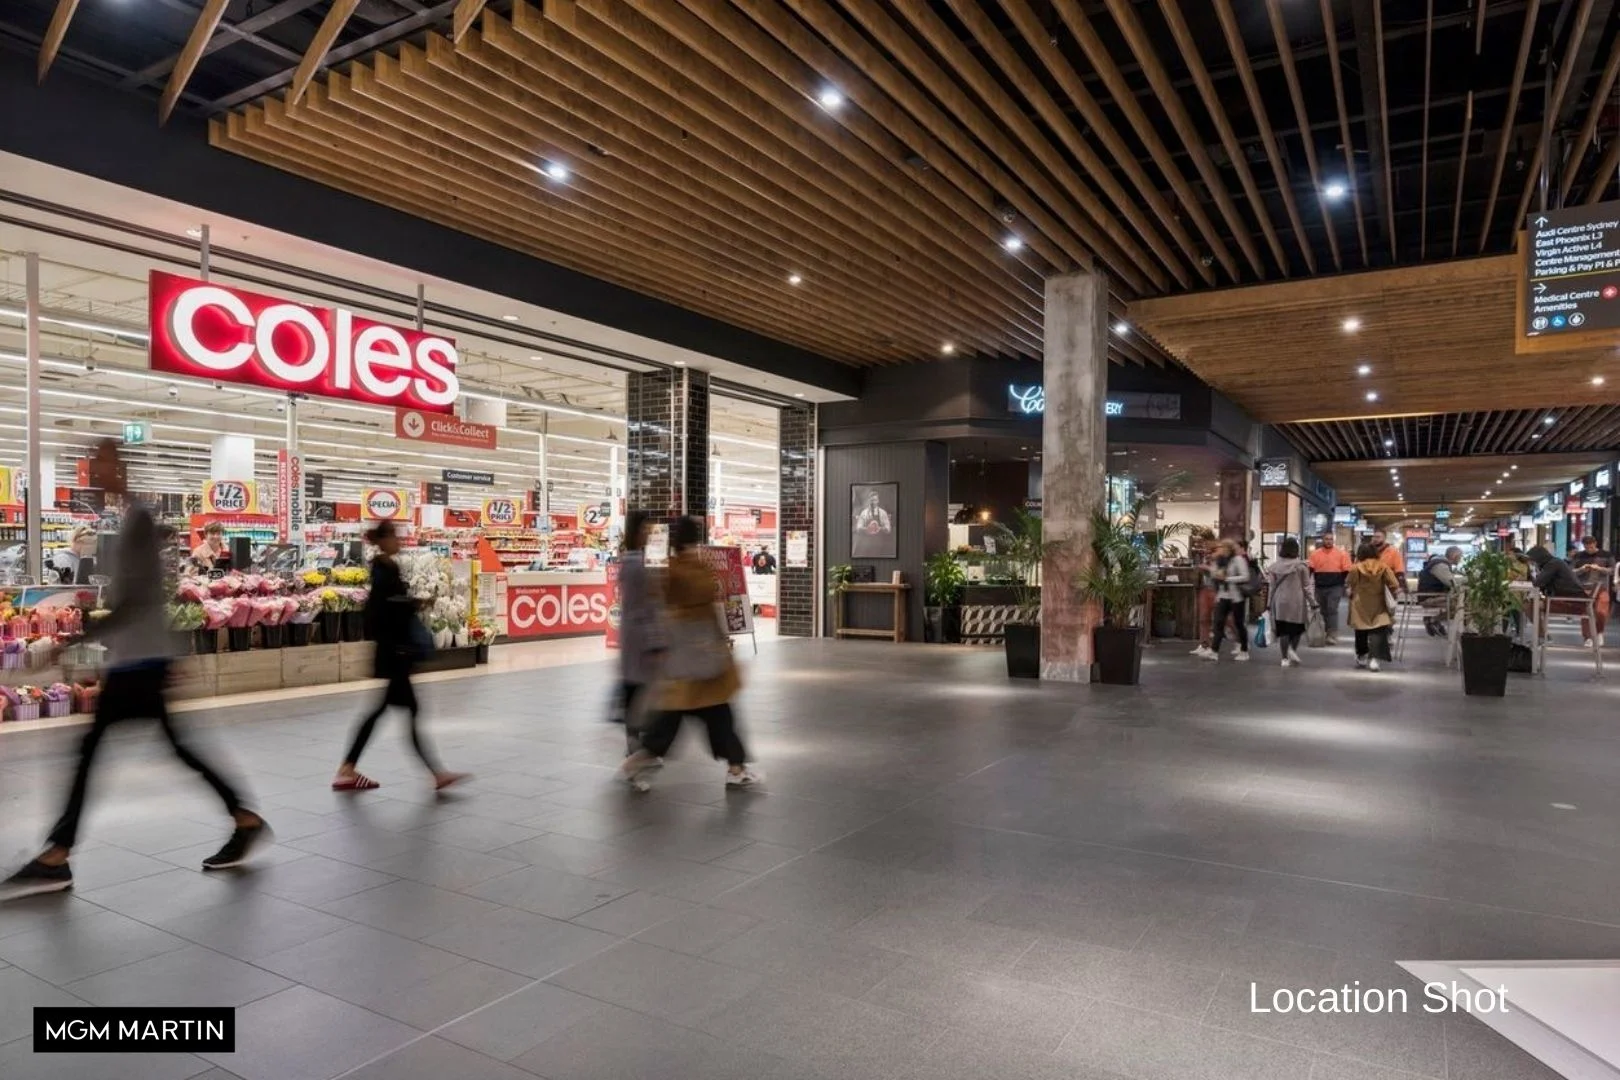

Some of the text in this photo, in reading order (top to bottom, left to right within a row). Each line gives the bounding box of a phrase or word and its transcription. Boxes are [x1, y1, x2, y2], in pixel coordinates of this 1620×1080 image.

[1536, 221, 1619, 238] Audi Centre Sydney
[1536, 231, 1603, 248] East Phoenix L3
[1536, 241, 1602, 257] Virgin Active L4
[1535, 257, 1562, 267] Centre
[1535, 266, 1568, 277] Parking
[1569, 264, 1576, 272] &
[1577, 263, 1593, 271] Pay
[1606, 259, 1613, 268] &
[1534, 290, 1600, 304] Medical Centre
[1534, 302, 1578, 313] Amenities
[173, 286, 460, 405] coles
[447, 472, 473, 481] Customer
[217, 483, 243, 500] 1/2
[215, 499, 245, 508] PRICE
[493, 502, 511, 513] 1/2
[491, 512, 512, 521] PRICE
[511, 584, 608, 629] coles
